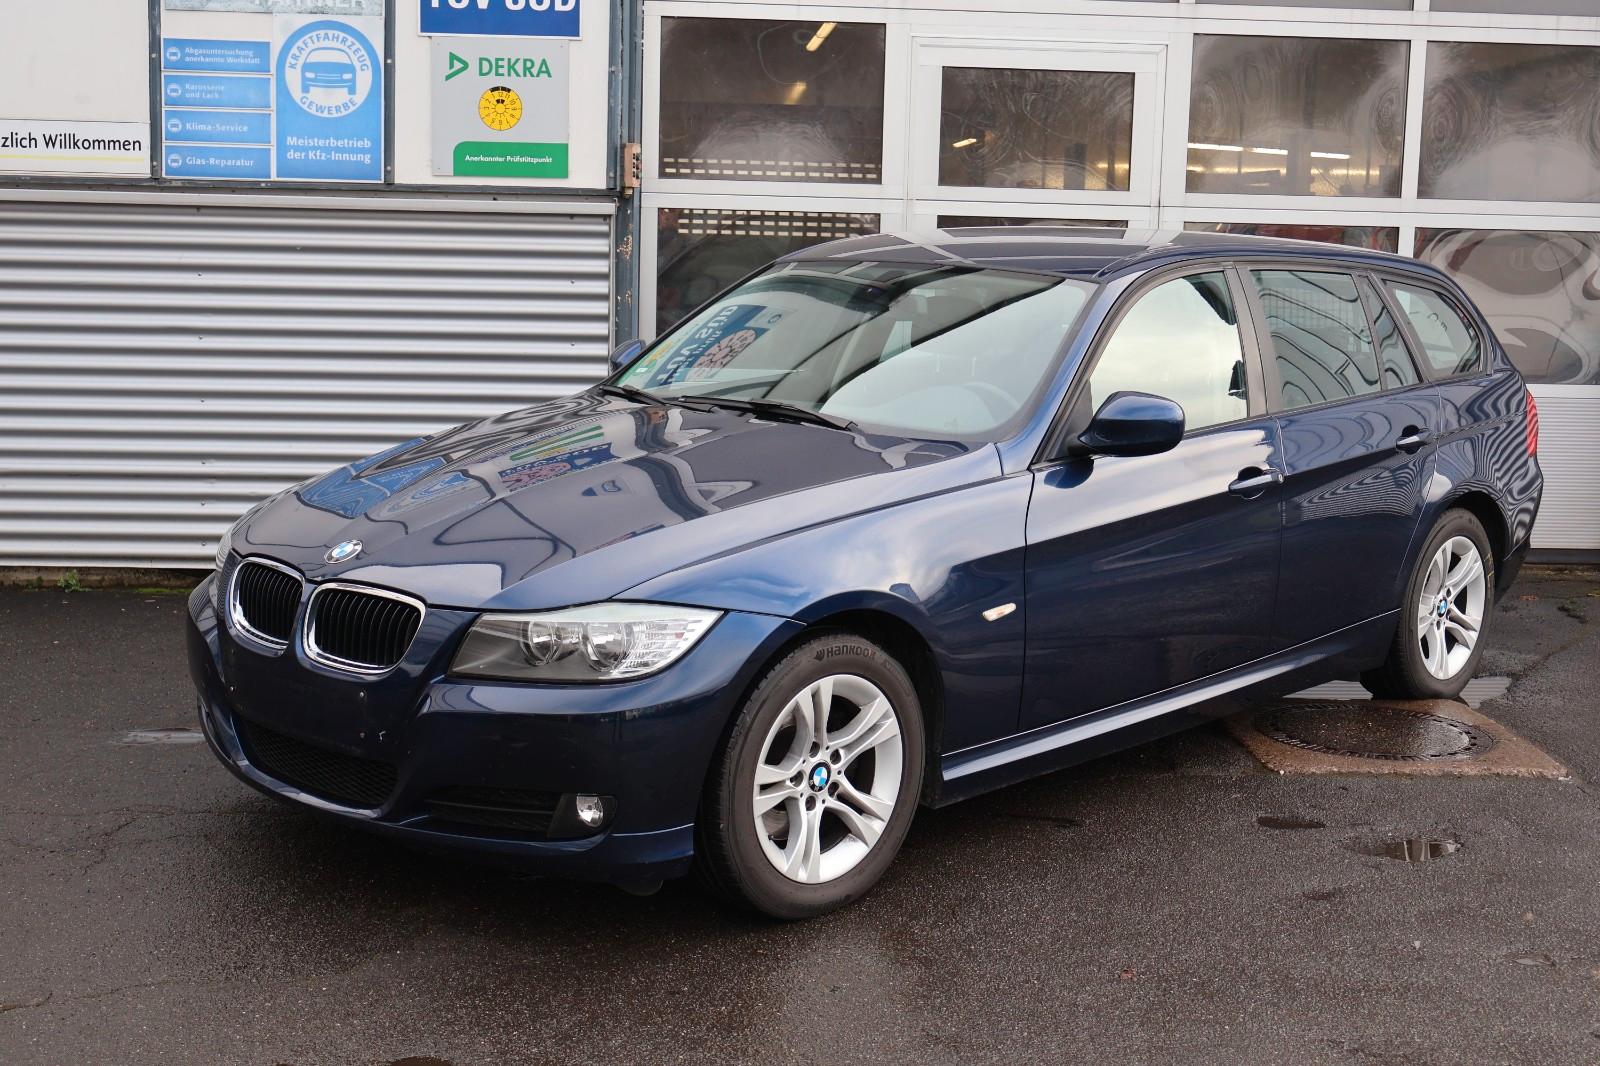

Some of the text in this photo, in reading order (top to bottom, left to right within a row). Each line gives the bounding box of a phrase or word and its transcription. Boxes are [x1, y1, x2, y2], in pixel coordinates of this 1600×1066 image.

[184, 47, 254, 57] Abgasuntersuchung
[288, 32, 369, 72] KRAFTFAHRZEUG
[226, 56, 261, 64] Werkstatt
[478, 57, 552, 78] DEKRA
[185, 83, 225, 91] Karosserie
[300, 95, 358, 115] GEWERBE
[186, 122, 249, 132] Klima-Service
[0, 131, 142, 151] zlich Willkommen
[286, 136, 371, 148] Meisterbetrieb
[186, 156, 254, 167] Glas-Reparatur
[287, 149, 371, 164] der Kfz-Innung
[464, 154, 553, 164] Anerkannter Prüfstützpunkt
